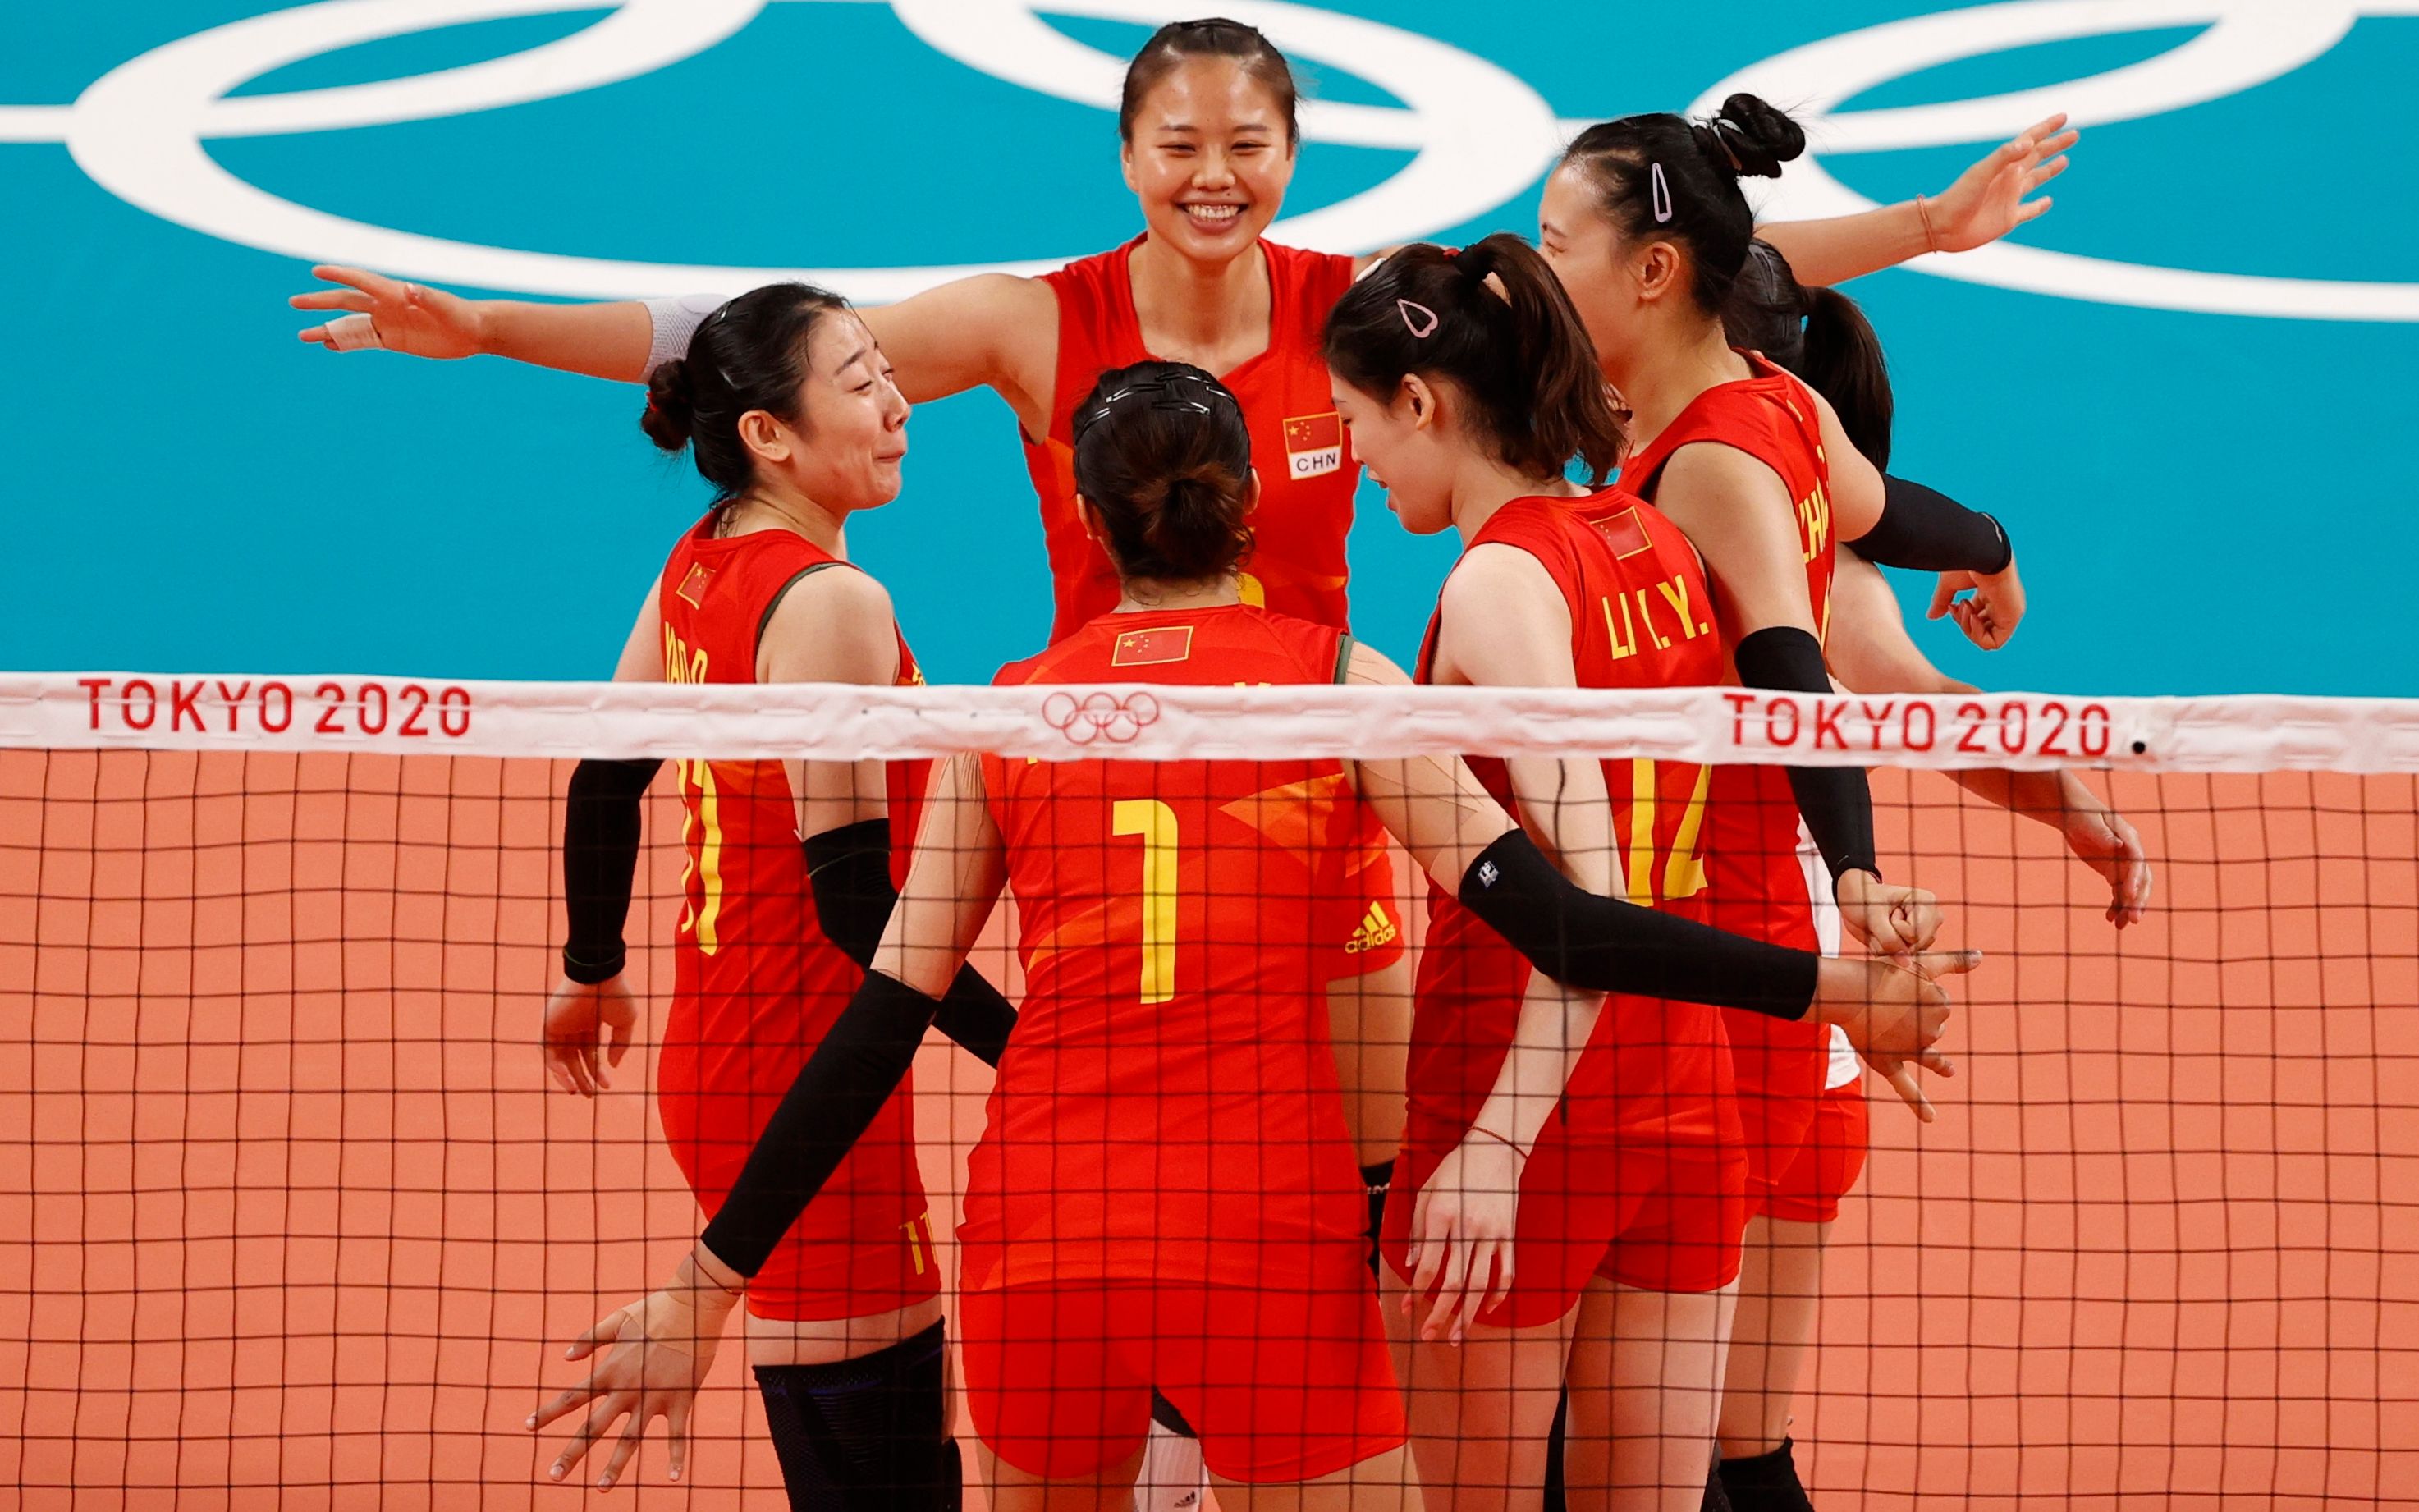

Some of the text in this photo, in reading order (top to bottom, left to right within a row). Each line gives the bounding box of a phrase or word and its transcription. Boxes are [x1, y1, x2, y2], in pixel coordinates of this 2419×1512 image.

[1297, 452, 1335, 472] CHN
[1602, 592, 1638, 660] LI
[78, 679, 470, 737] TOKYO 2020
[1724, 694, 2110, 757] TOKYO 2020
[1112, 799, 1179, 1004] 1
[1345, 924, 1396, 954] adidas
